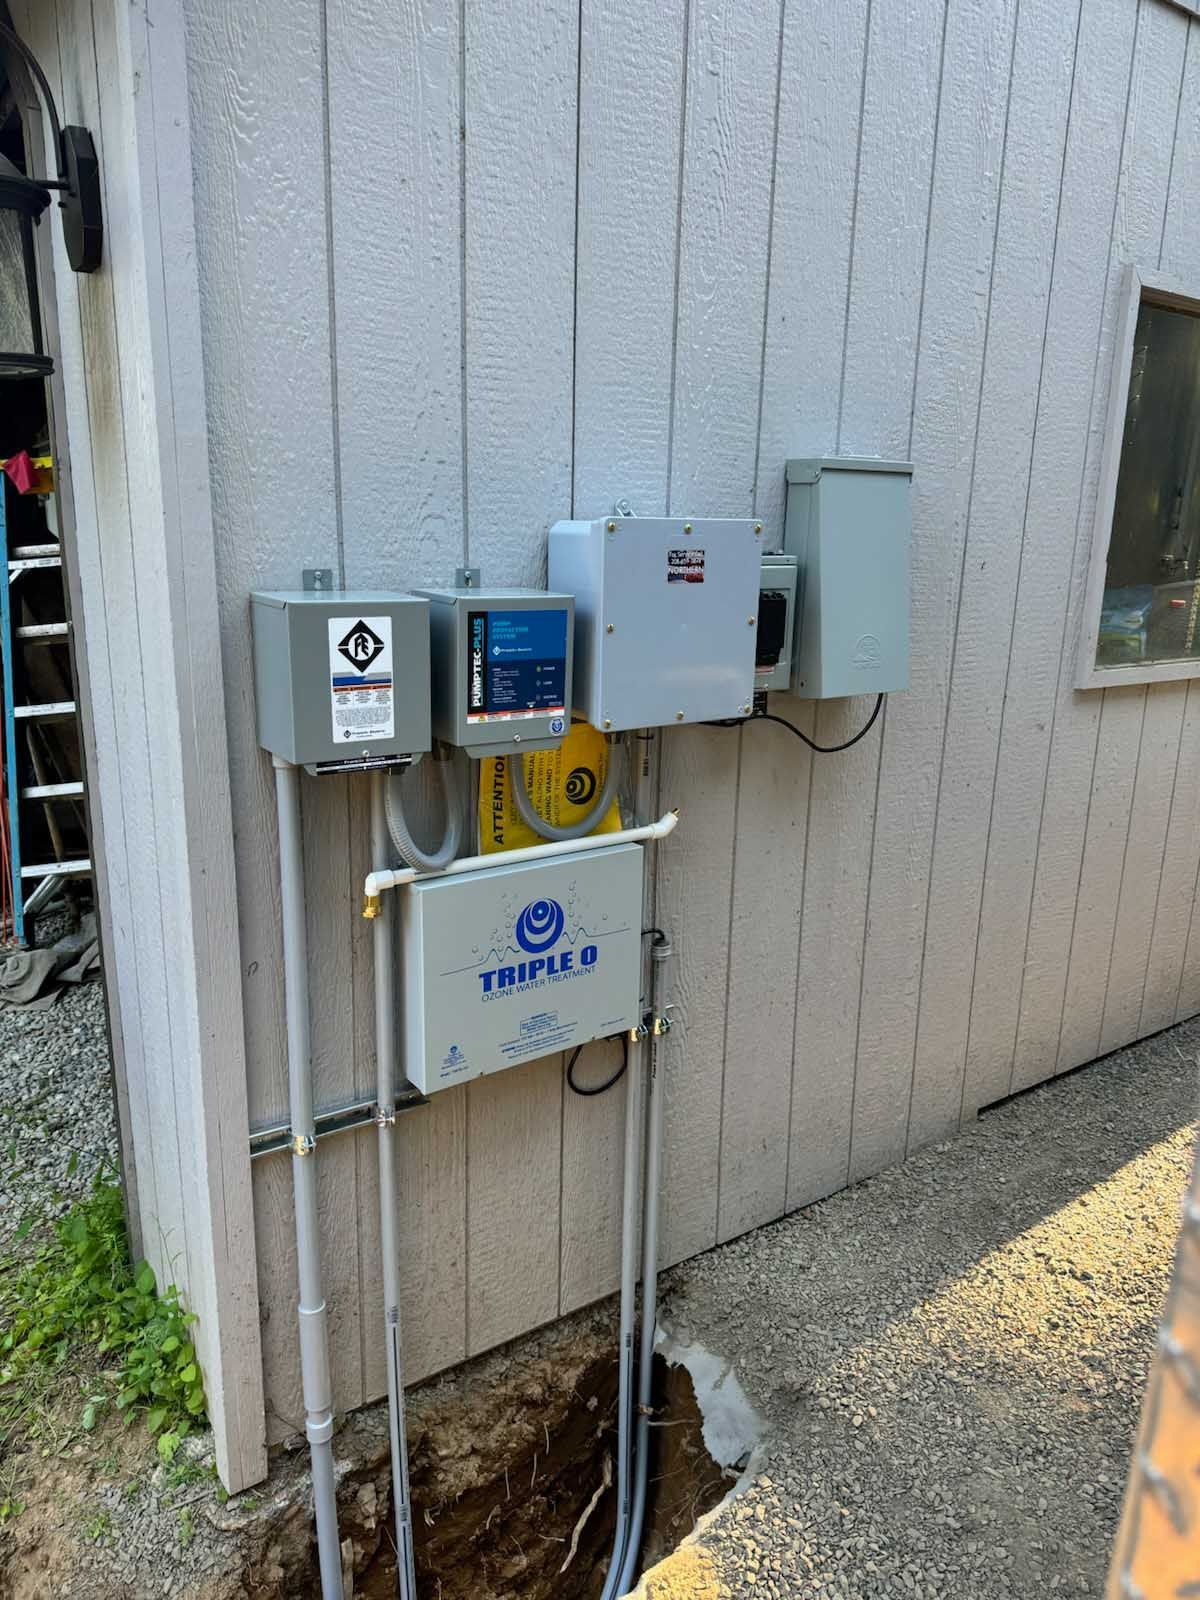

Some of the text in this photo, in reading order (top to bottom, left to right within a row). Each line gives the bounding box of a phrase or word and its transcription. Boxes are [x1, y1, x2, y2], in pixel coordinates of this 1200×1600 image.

[479, 944, 598, 993] TRIPLE O
[481, 965, 596, 1003] OZONE WATER TREATMENT
